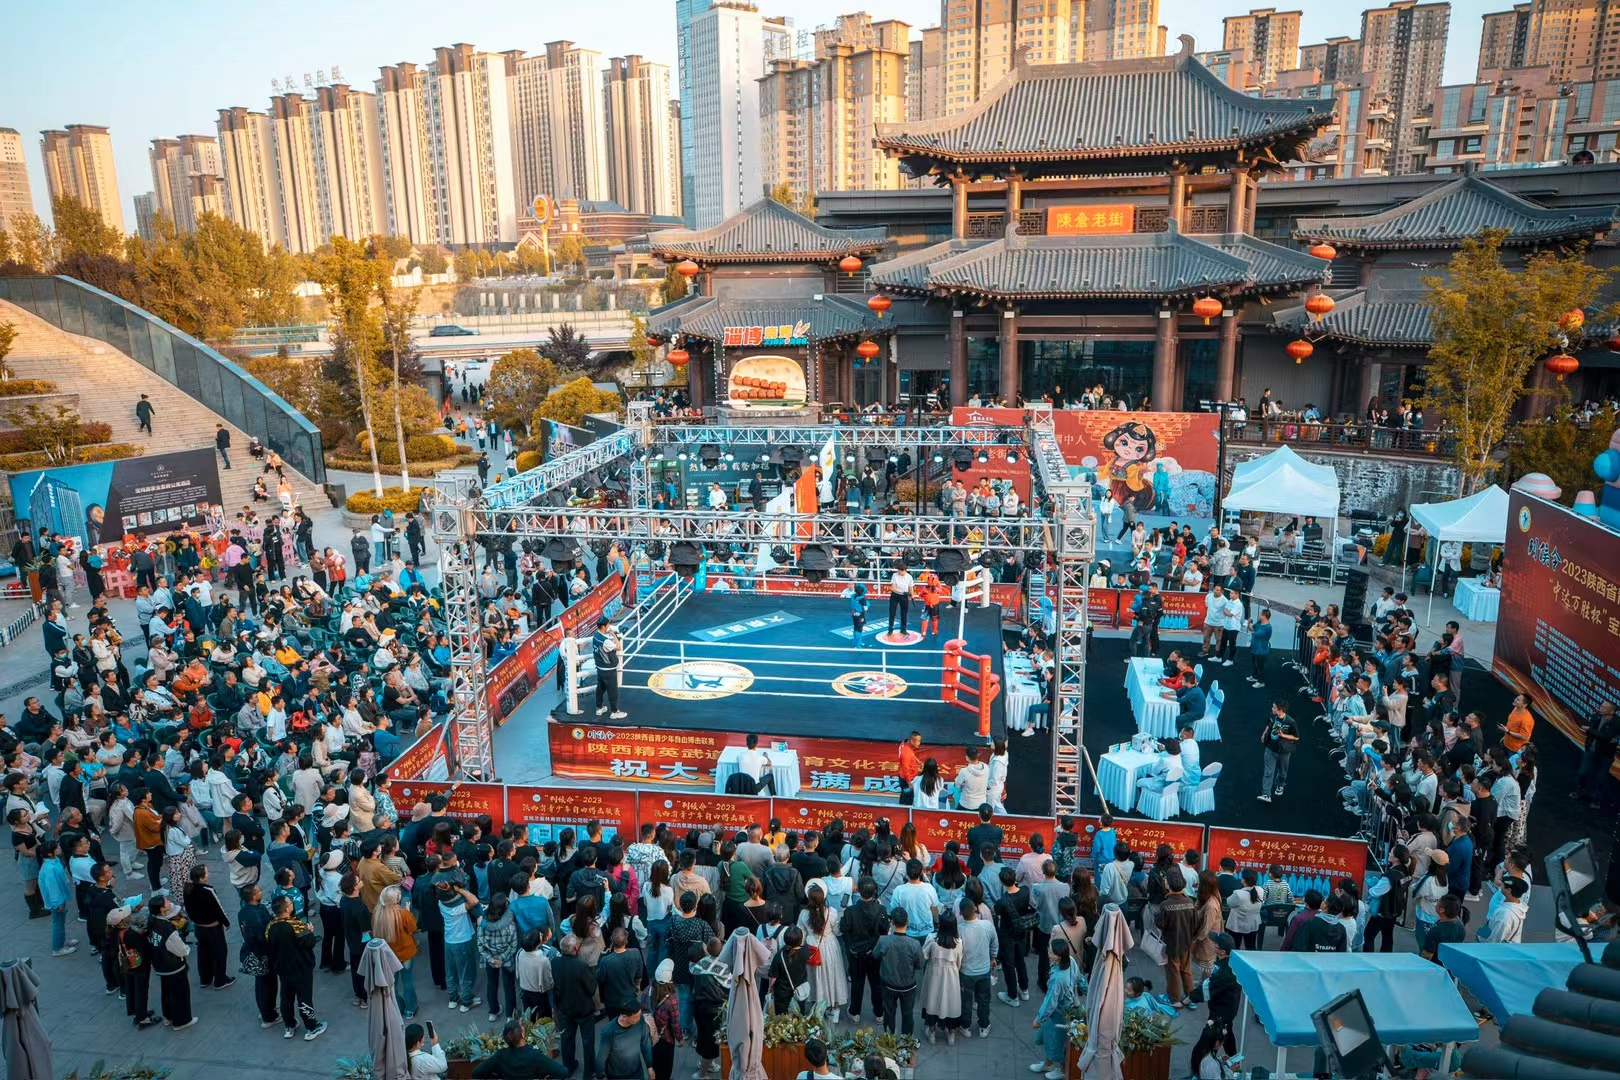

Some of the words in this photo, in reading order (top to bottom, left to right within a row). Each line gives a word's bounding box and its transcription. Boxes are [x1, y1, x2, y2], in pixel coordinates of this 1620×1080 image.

[583, 796, 602, 804] 2023
[716, 803, 736, 812] 2023
[852, 812, 873, 820] 2023
[1143, 829, 1165, 839] 2023
[1301, 843, 1325, 853] 2023
